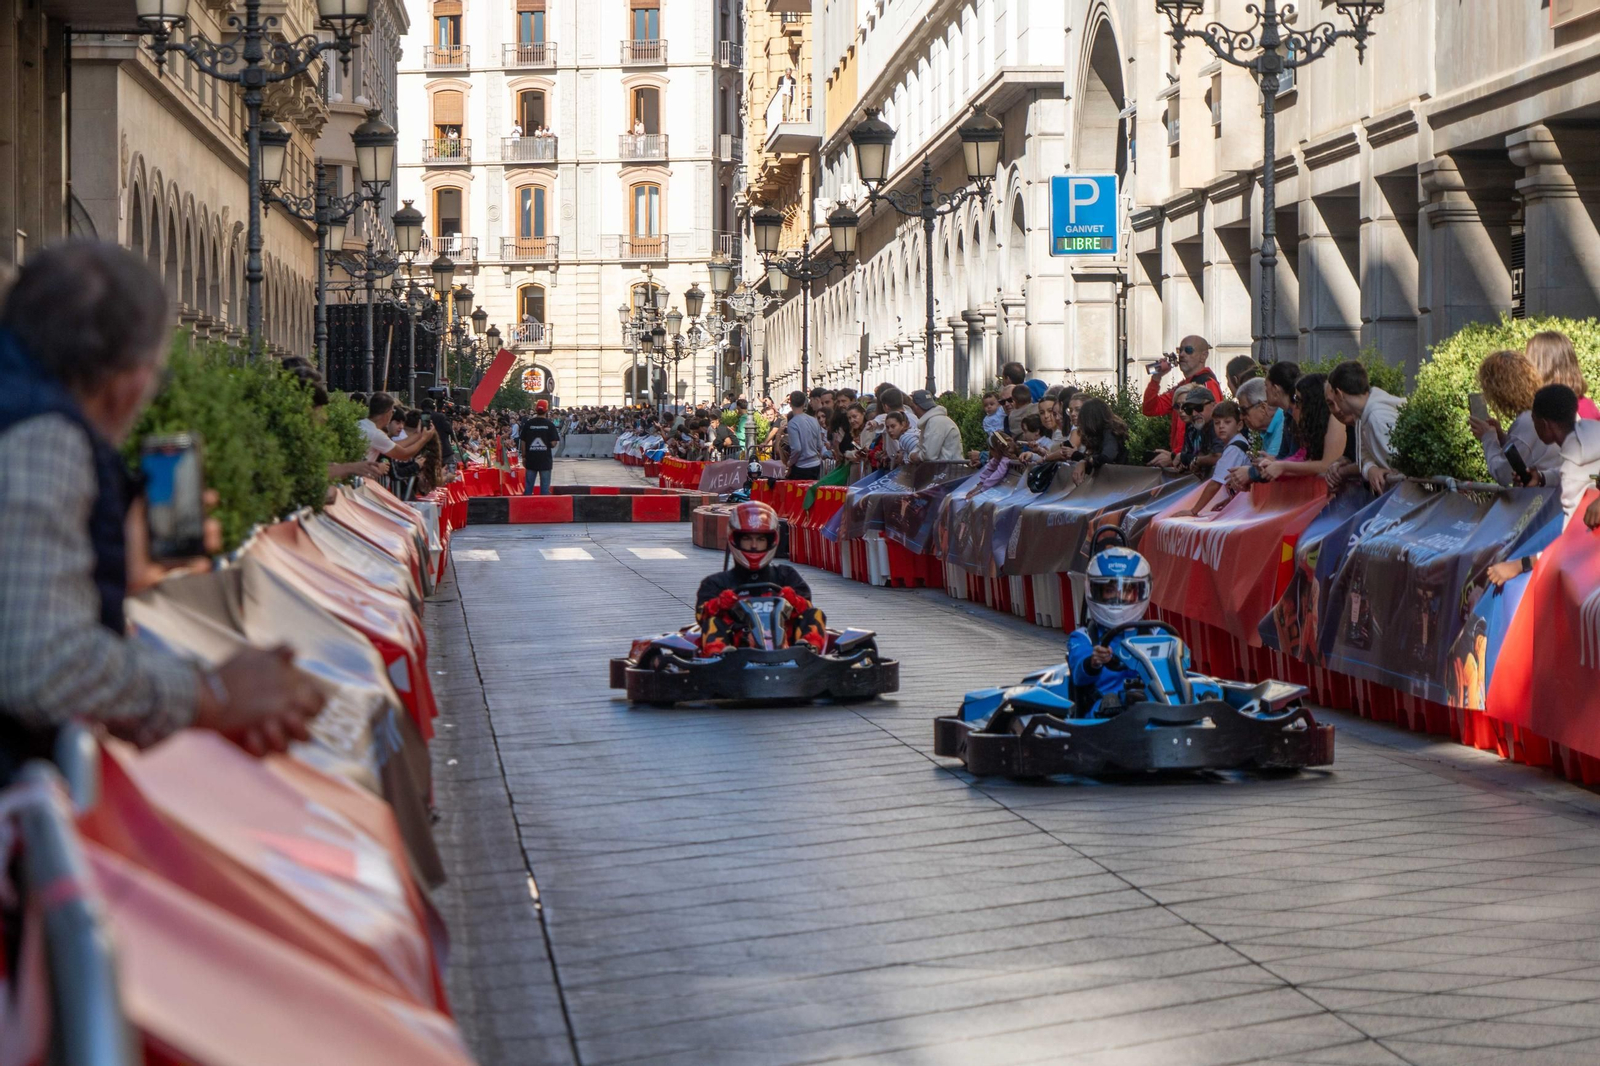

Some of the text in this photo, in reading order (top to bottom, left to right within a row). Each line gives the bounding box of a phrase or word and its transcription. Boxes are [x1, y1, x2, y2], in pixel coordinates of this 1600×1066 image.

[1068, 178, 1100, 224] P
[1065, 225, 1105, 233] GANIVET
[1064, 237, 1101, 250] LIBRE
[709, 466, 741, 490] MELIÁ
[1108, 562, 1127, 570] prime
[752, 601, 775, 613] 26
[1146, 645, 1161, 657] 1
